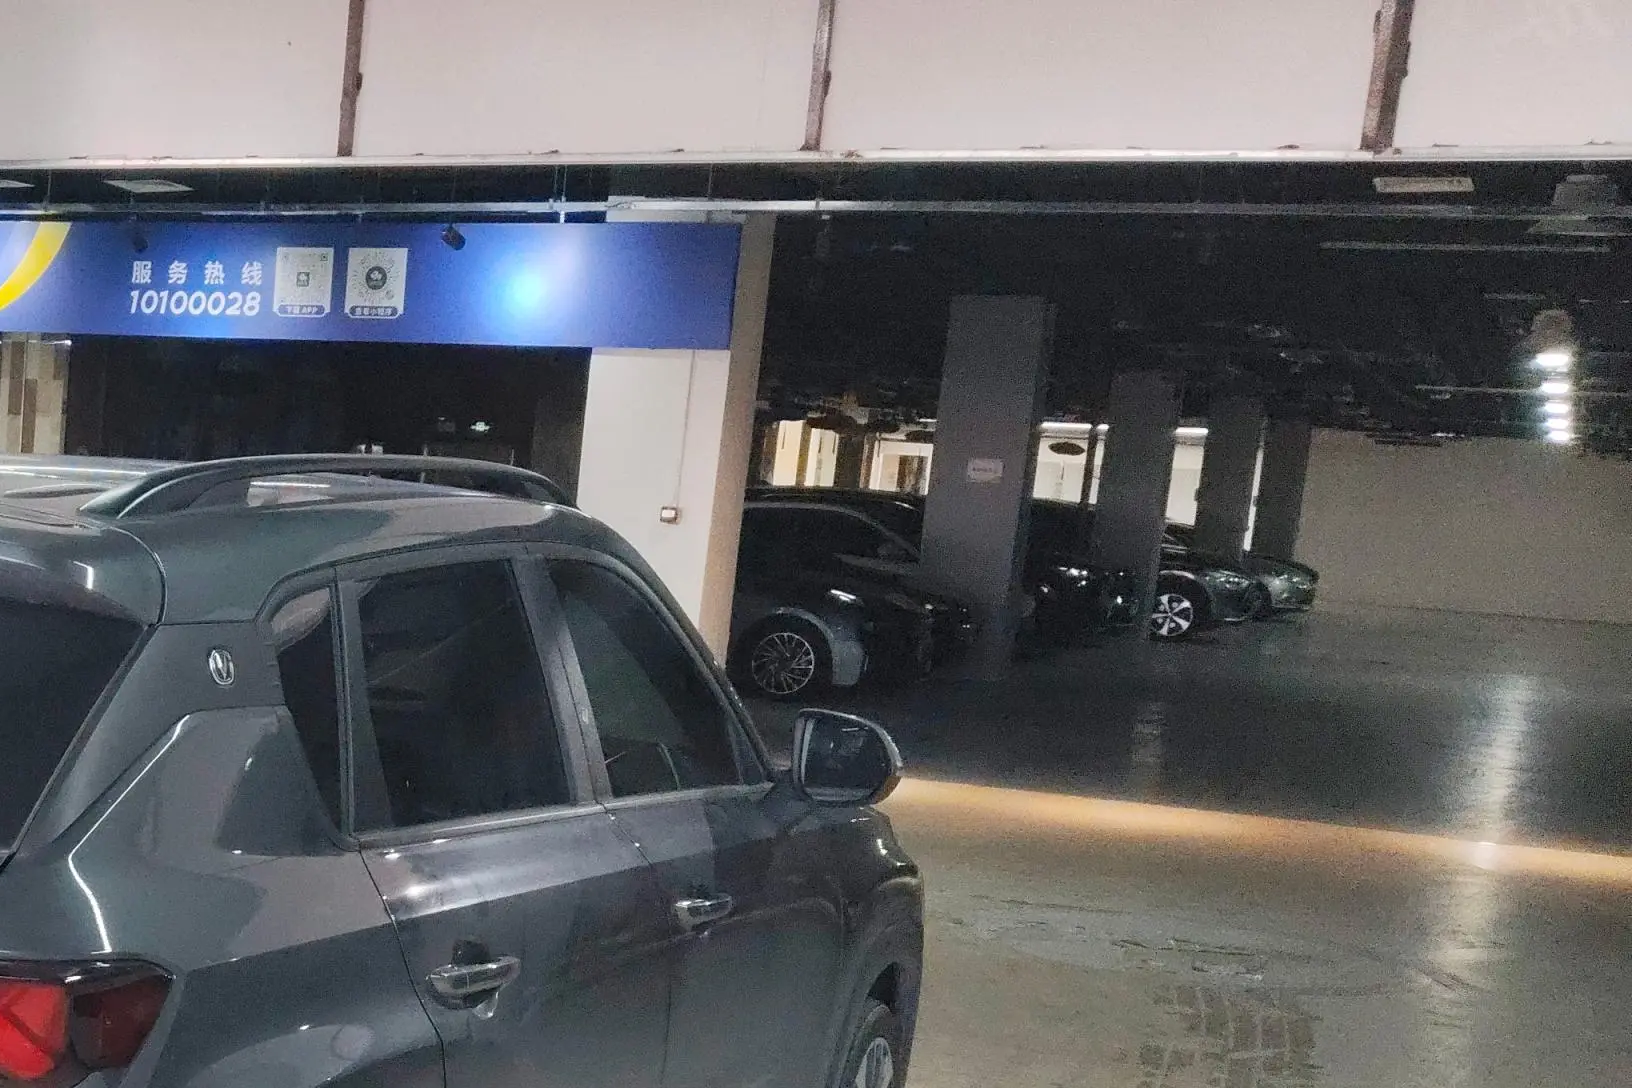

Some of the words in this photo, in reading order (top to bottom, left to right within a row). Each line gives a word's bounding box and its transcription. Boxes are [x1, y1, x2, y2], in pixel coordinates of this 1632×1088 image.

[131, 260, 263, 285] 服务热线
[130, 289, 261, 316] 10100028
